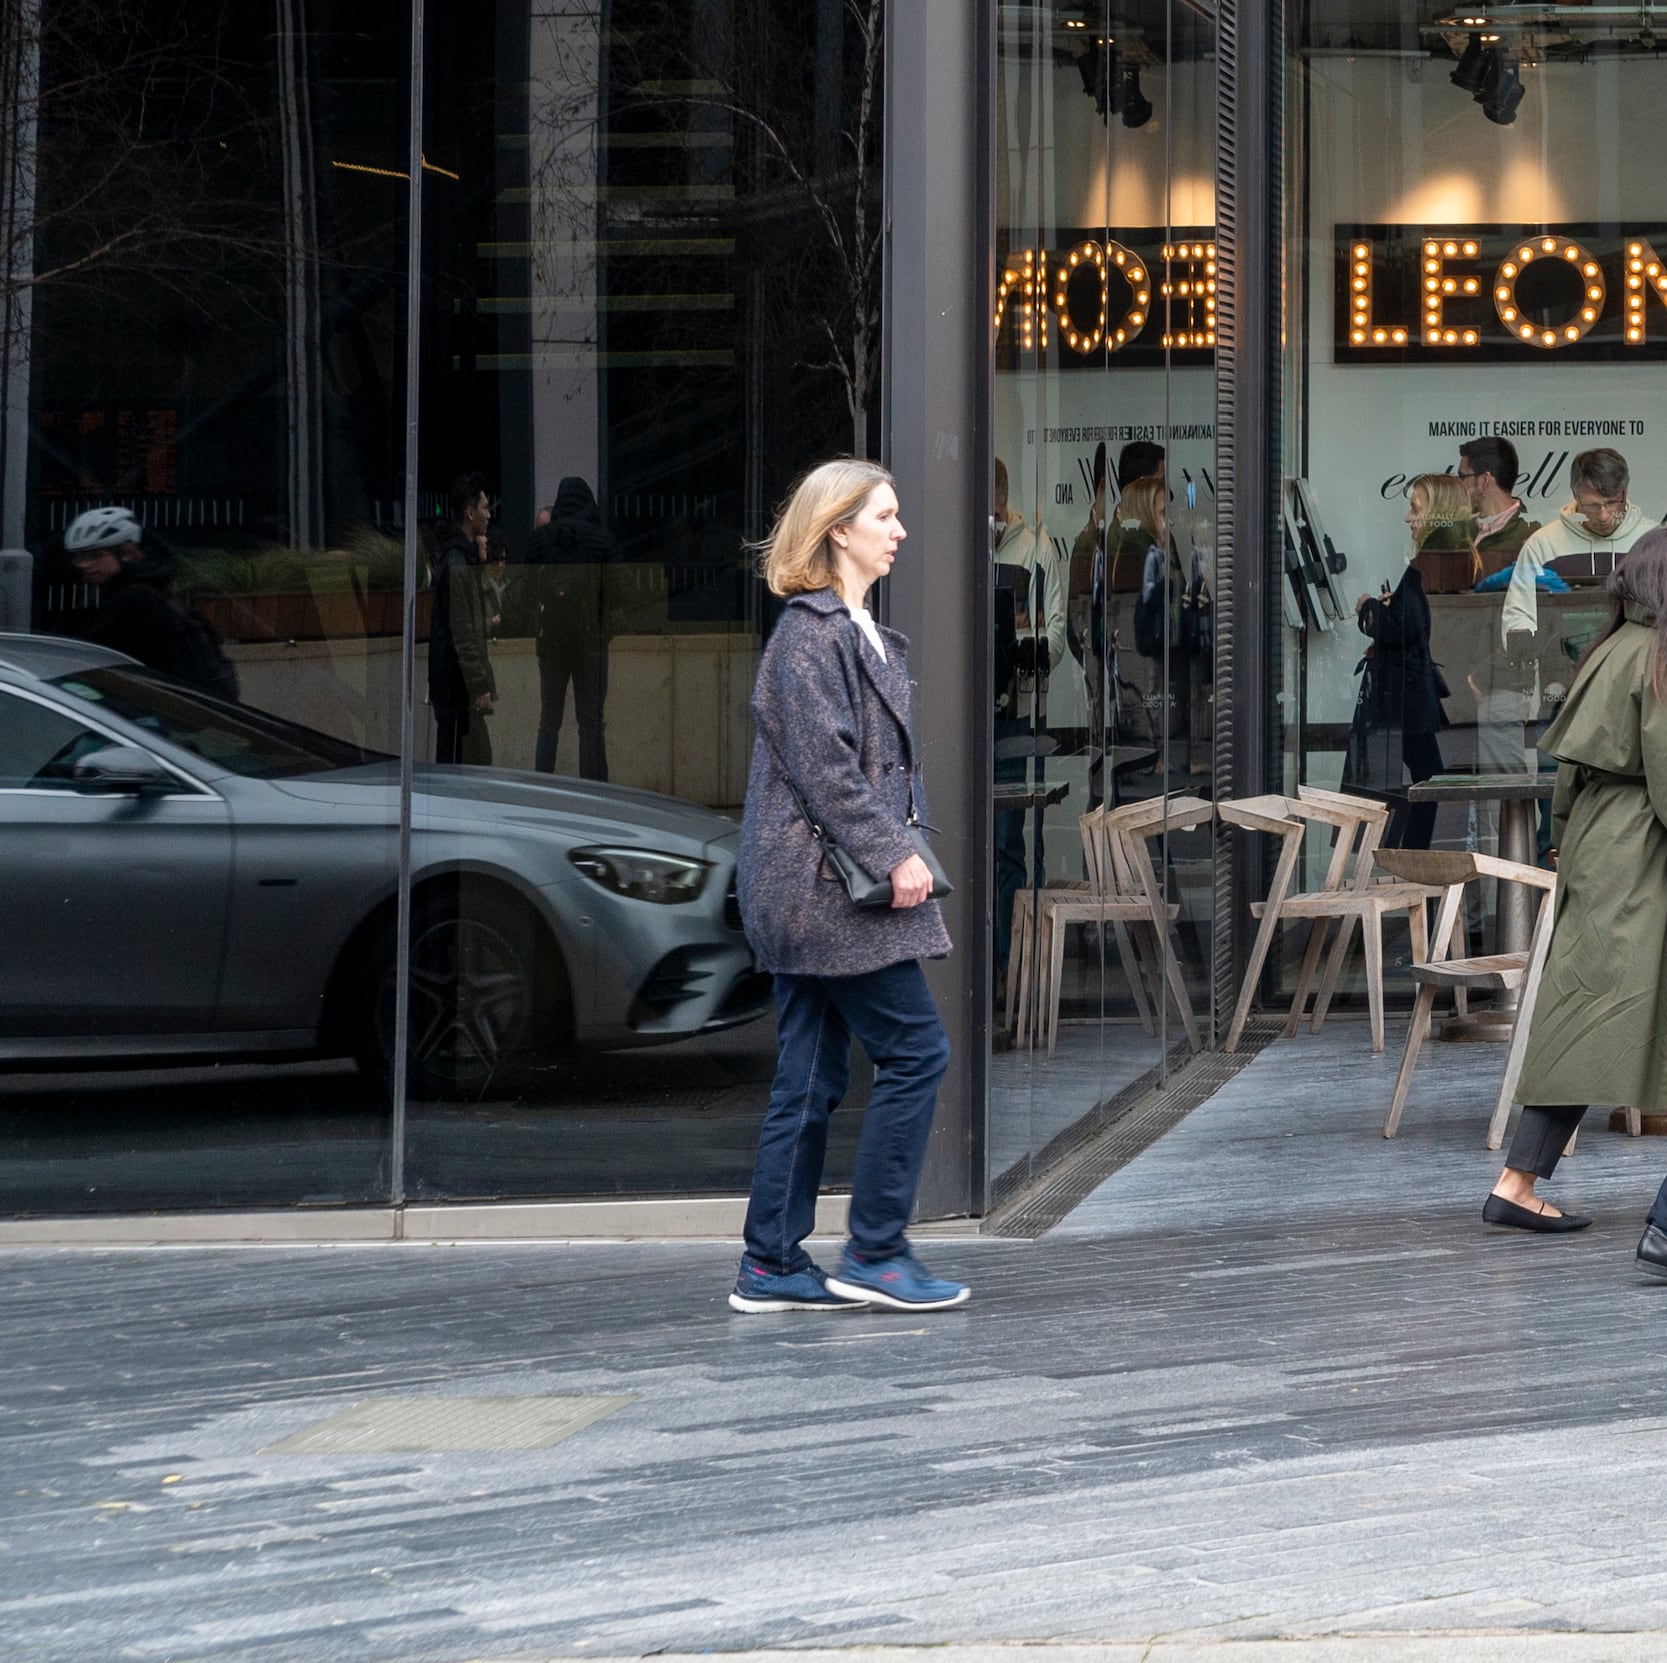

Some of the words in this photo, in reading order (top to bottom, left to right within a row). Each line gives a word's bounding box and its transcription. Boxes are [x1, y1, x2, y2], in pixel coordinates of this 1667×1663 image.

[1428, 421, 1476, 437] MAKING
[1479, 421, 1490, 436] IT
[1493, 421, 1536, 437] EASIER
[1538, 420, 1561, 436] FOR
[1564, 420, 1626, 436] EVERYONE
[1628, 420, 1644, 435] TO
[1409, 513, 1454, 521] NATURALLY
[1431, 520, 1454, 528] FOOD
[1543, 694, 1567, 702] FOOD
